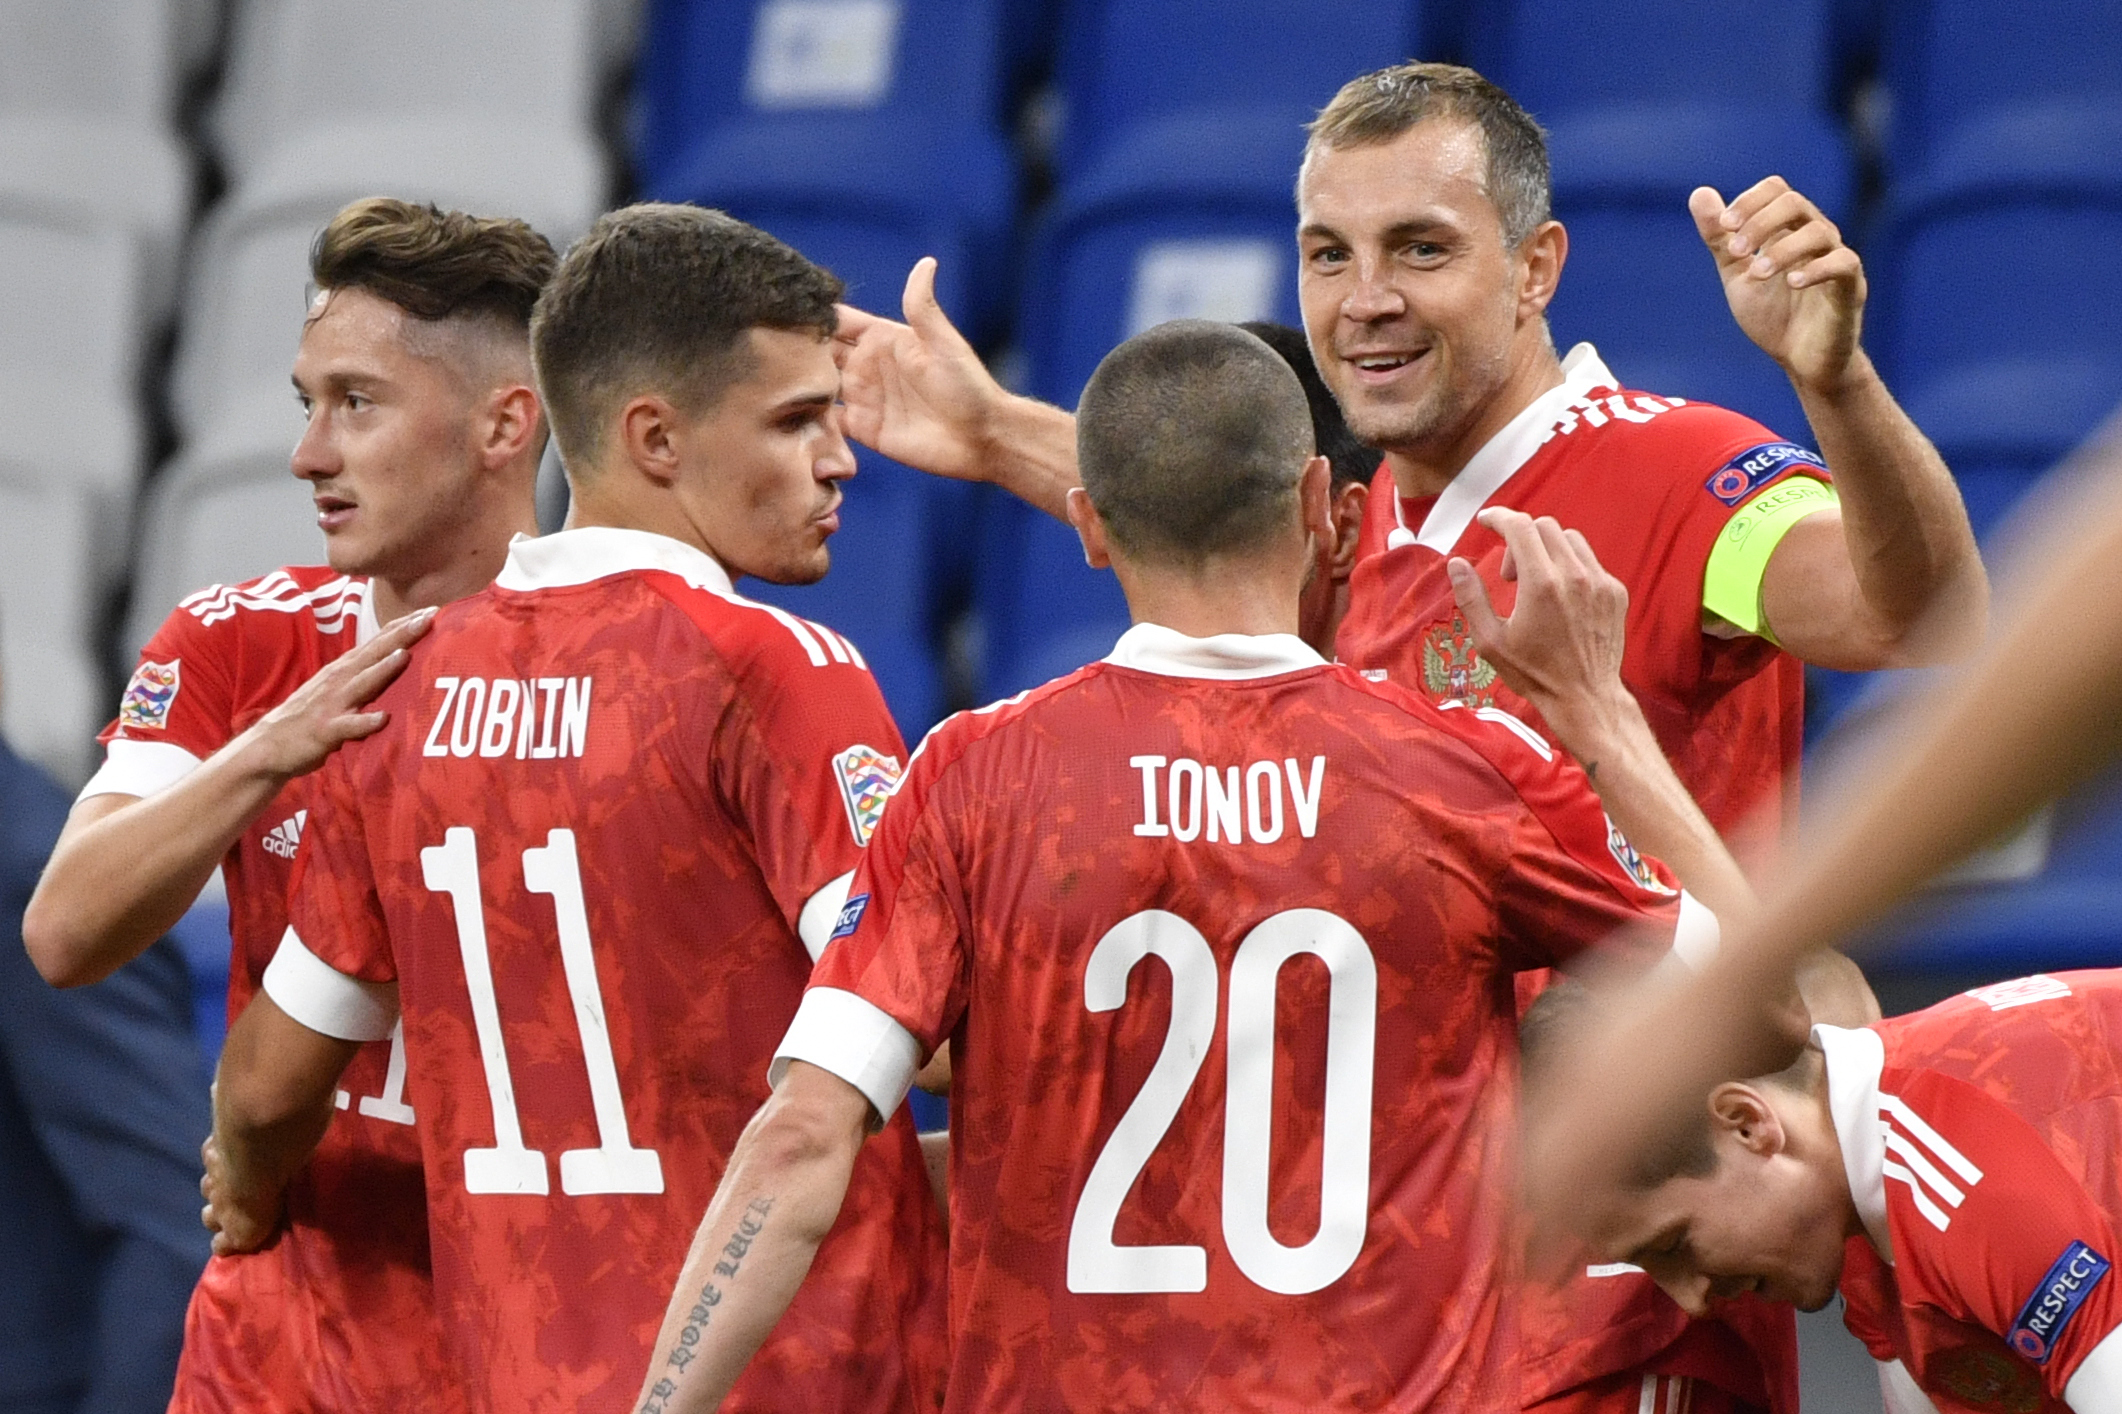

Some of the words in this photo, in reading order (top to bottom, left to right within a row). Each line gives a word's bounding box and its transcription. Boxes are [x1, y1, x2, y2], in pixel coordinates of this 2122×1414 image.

[422, 675, 593, 761] ZOBNIN
[1129, 754, 1327, 845] IONOV
[419, 825, 665, 1197] 11
[1066, 907, 1378, 1296] 20
[2028, 1247, 2097, 1336] RESPECT
